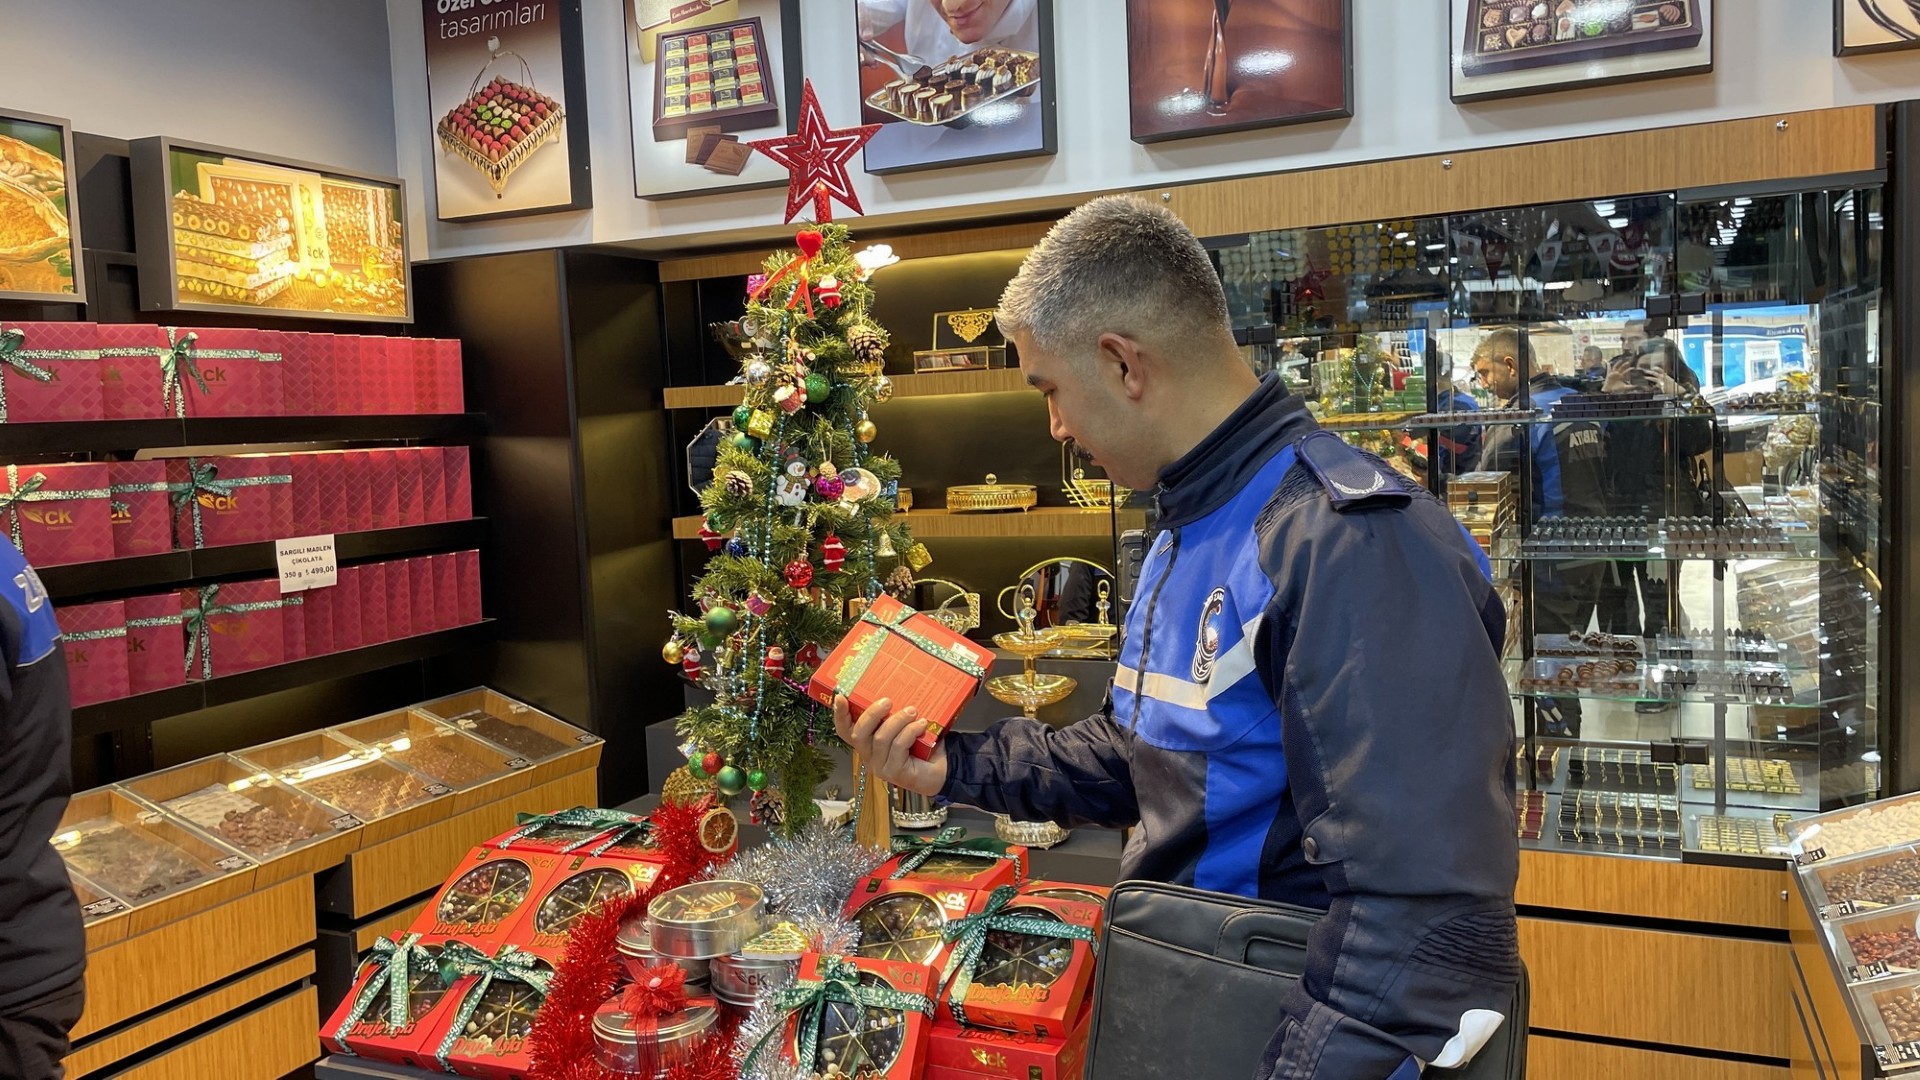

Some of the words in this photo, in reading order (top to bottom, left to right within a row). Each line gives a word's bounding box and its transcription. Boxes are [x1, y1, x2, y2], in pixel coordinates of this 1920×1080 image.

[440, 2, 545, 39] tasarımları
[203, 366, 227, 382] ck
[215, 495, 238, 510] ck
[45, 508, 73, 525] ck
[280, 548, 305, 556] SARGILI
[307, 545, 332, 553] MADLEN
[311, 565, 334, 574] 499,00
[946, 891, 968, 907] ck
[1072, 909, 1093, 921] ck
[747, 974, 767, 986] ck
[902, 971, 922, 986] ck
